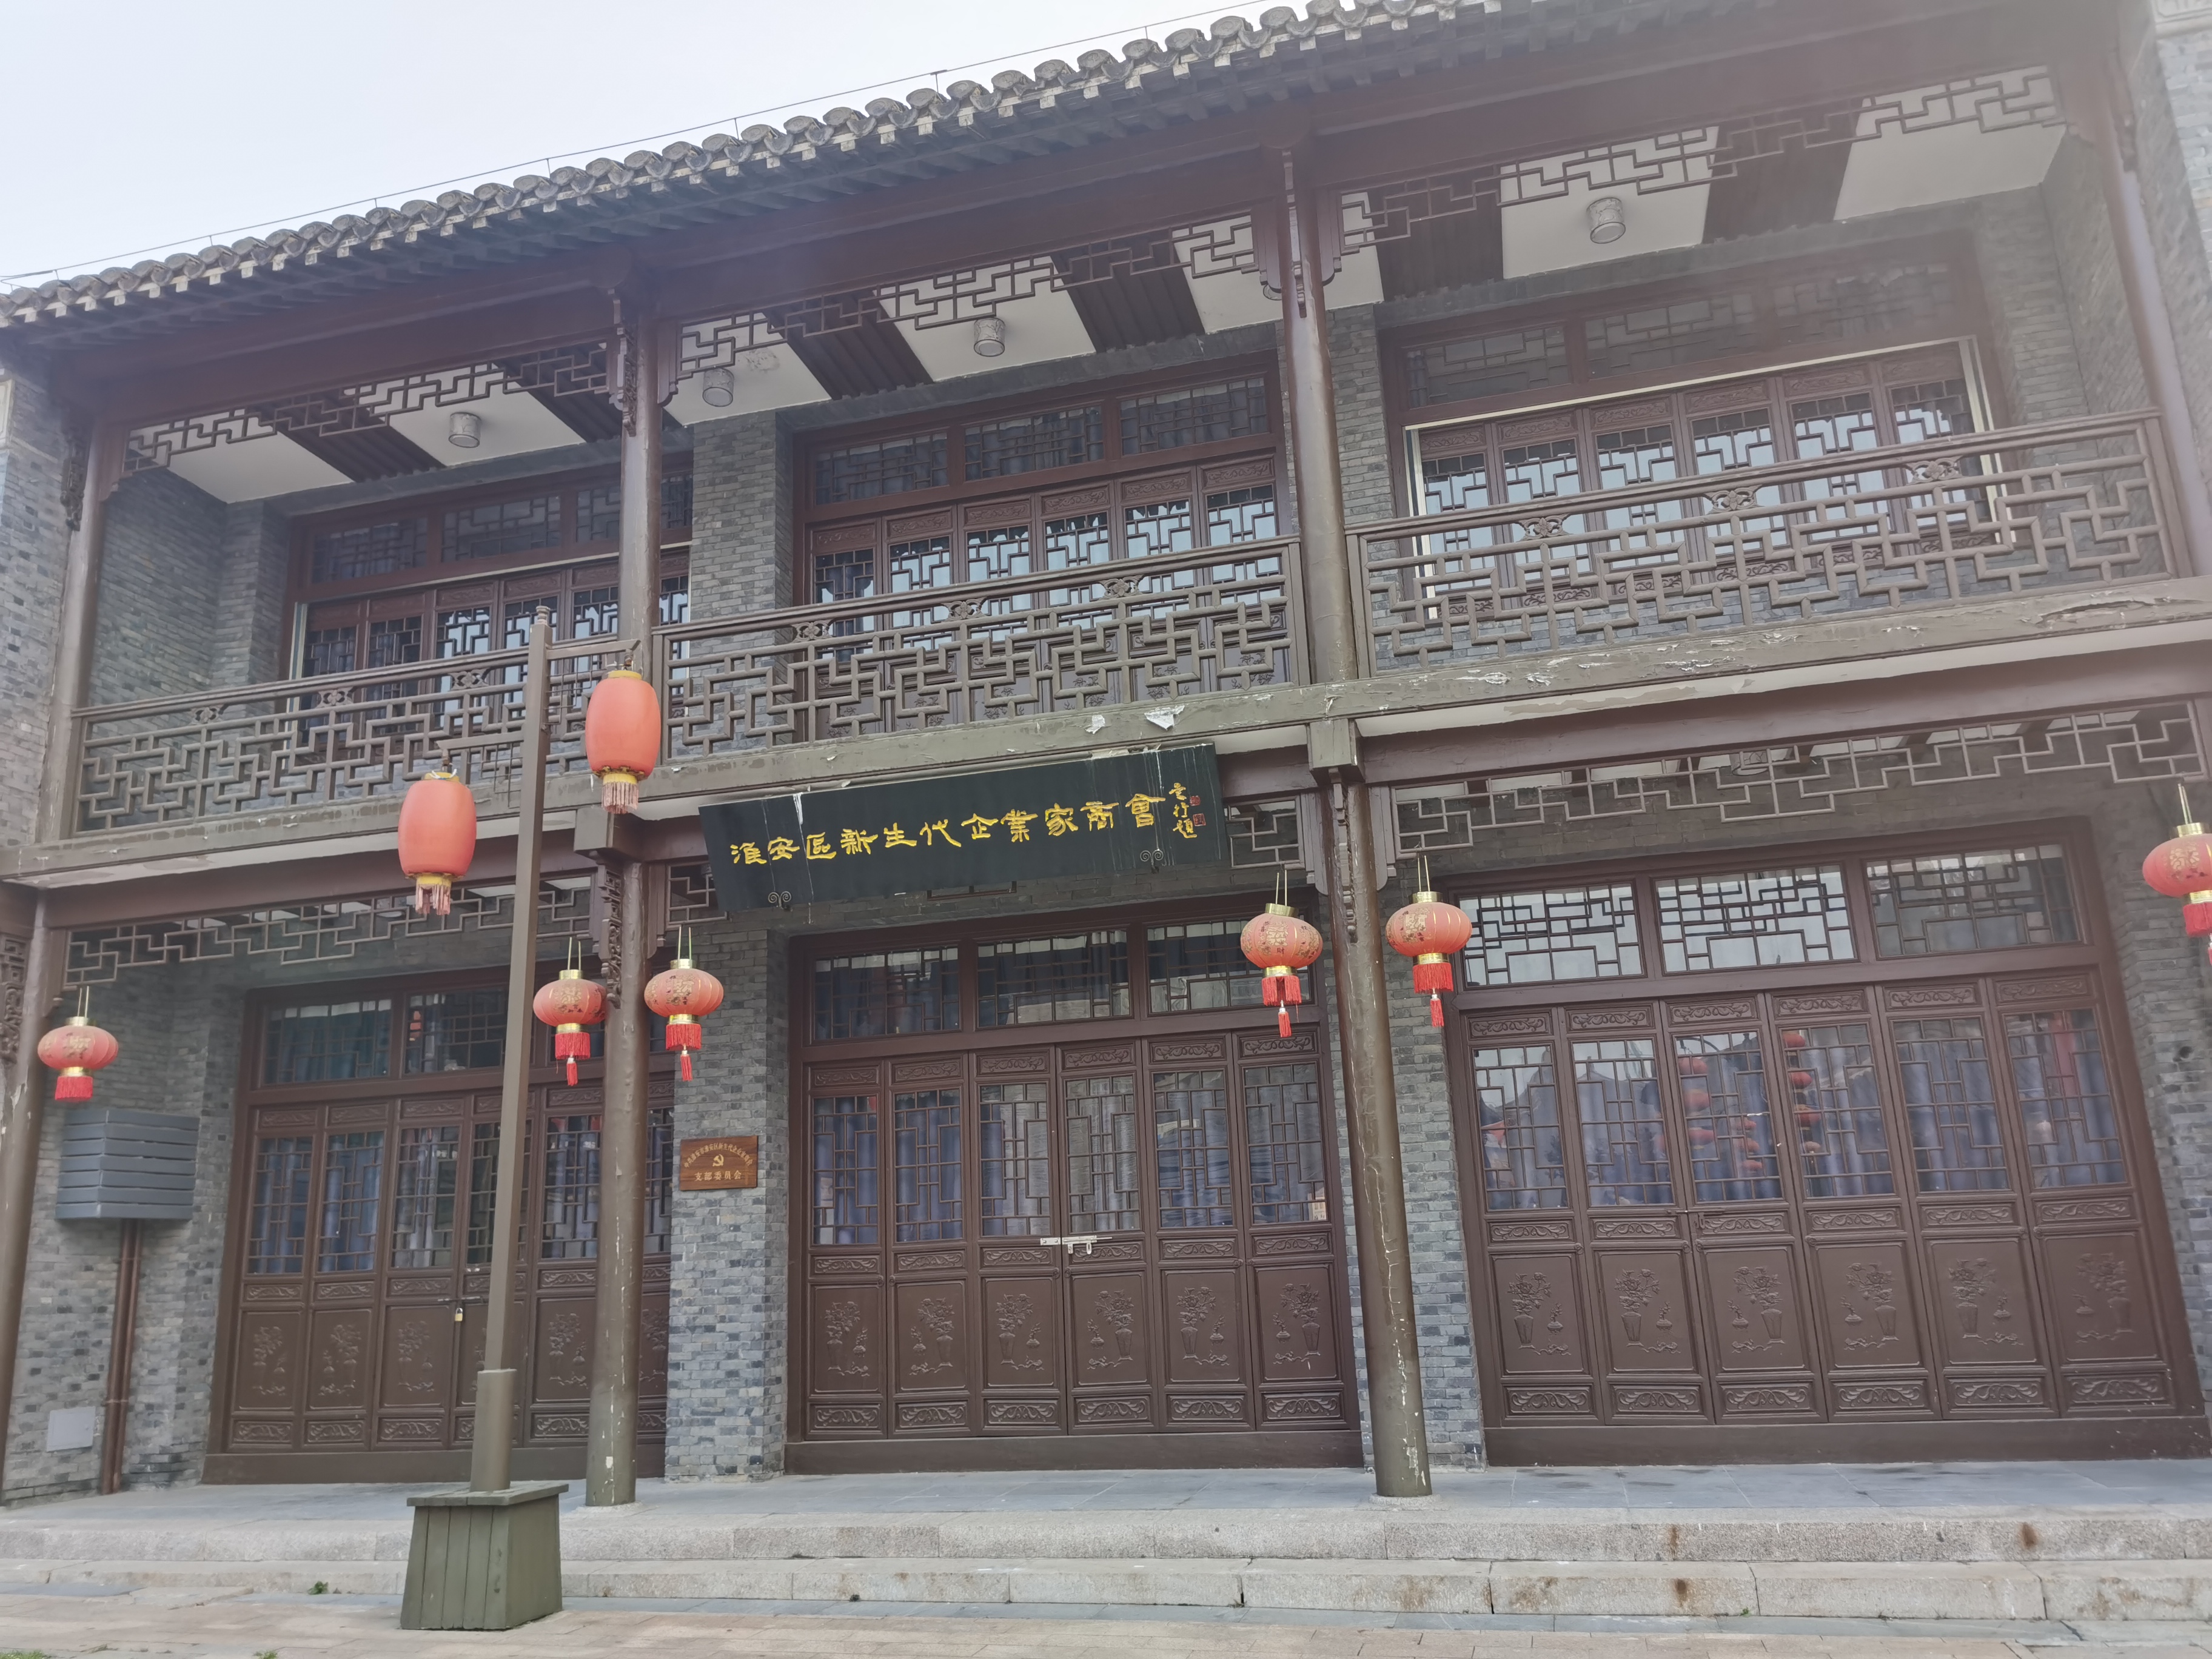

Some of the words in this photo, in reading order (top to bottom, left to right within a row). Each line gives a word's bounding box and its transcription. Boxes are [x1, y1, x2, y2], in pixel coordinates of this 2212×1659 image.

[694, 1170, 742, 1181] 支部委员会
